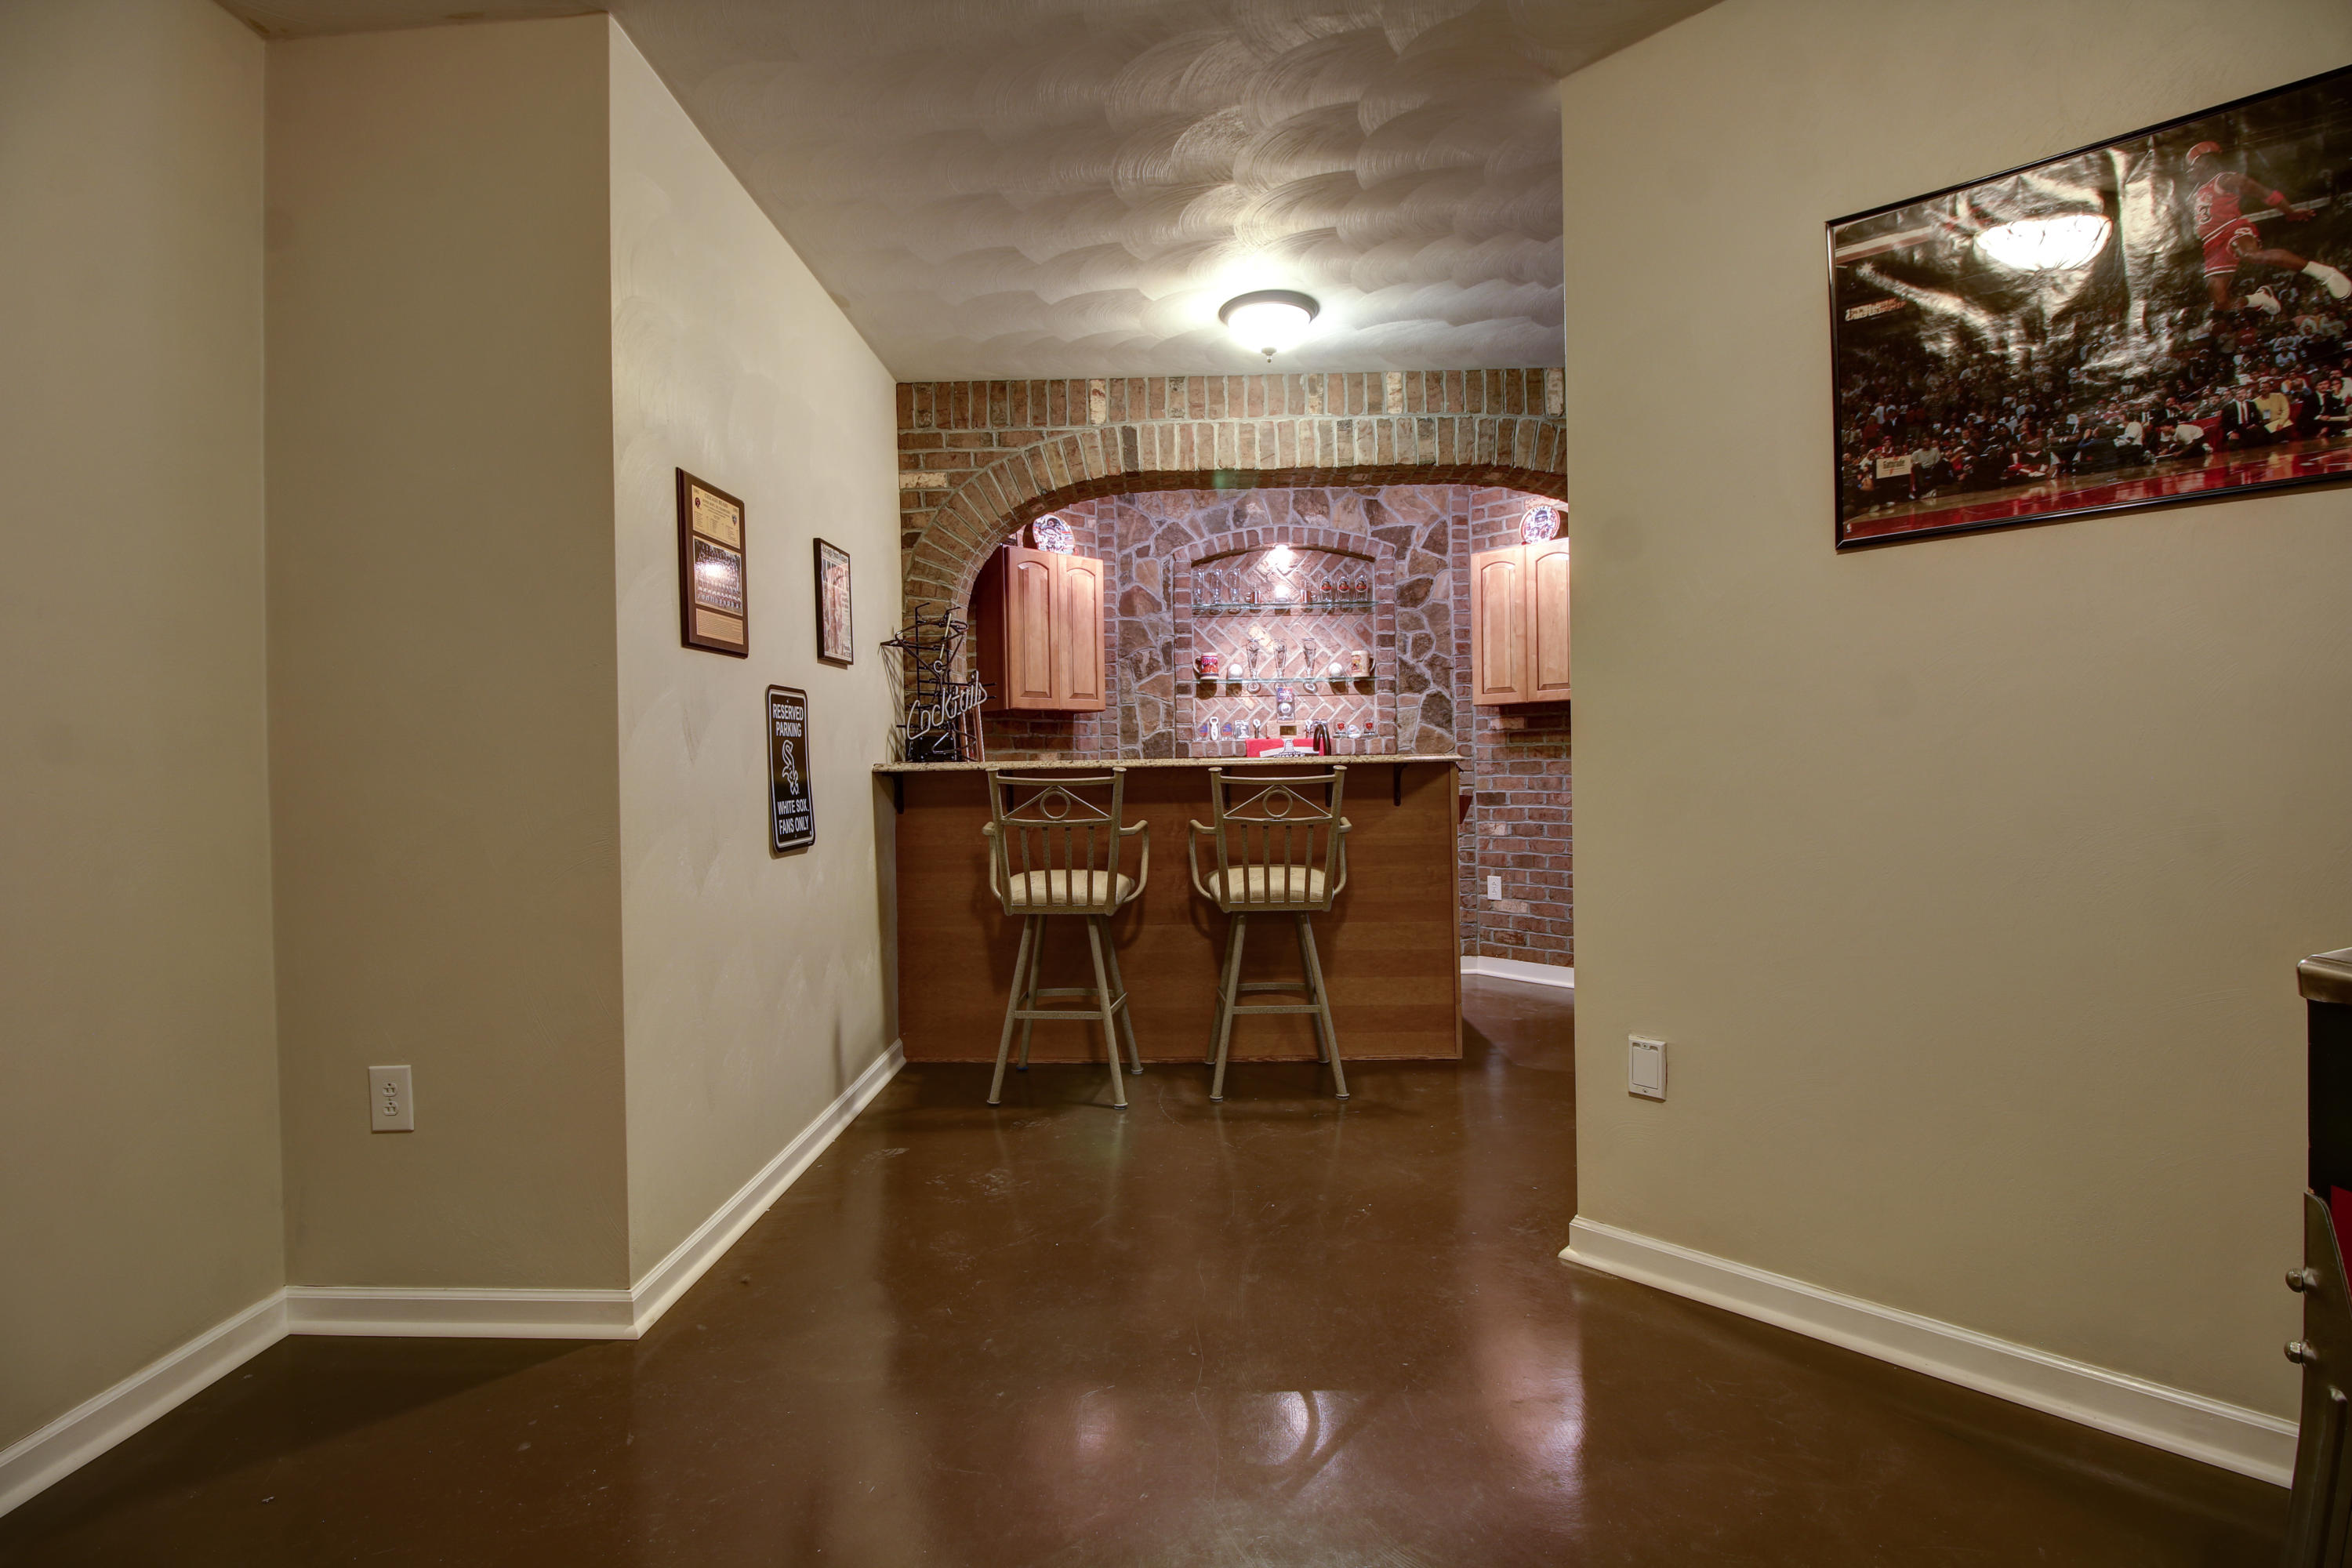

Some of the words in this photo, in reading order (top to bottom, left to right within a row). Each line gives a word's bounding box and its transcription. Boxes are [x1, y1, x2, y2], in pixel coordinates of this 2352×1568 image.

[772, 703, 804, 721] RESERVED
[906, 670, 988, 740] Cocktails
[775, 720, 802, 738] PARKING
[777, 800, 796, 815] WHITE
[796, 798, 808, 813] SOX
[779, 818, 794, 835] FANS
[794, 815, 809, 833] ONLY
